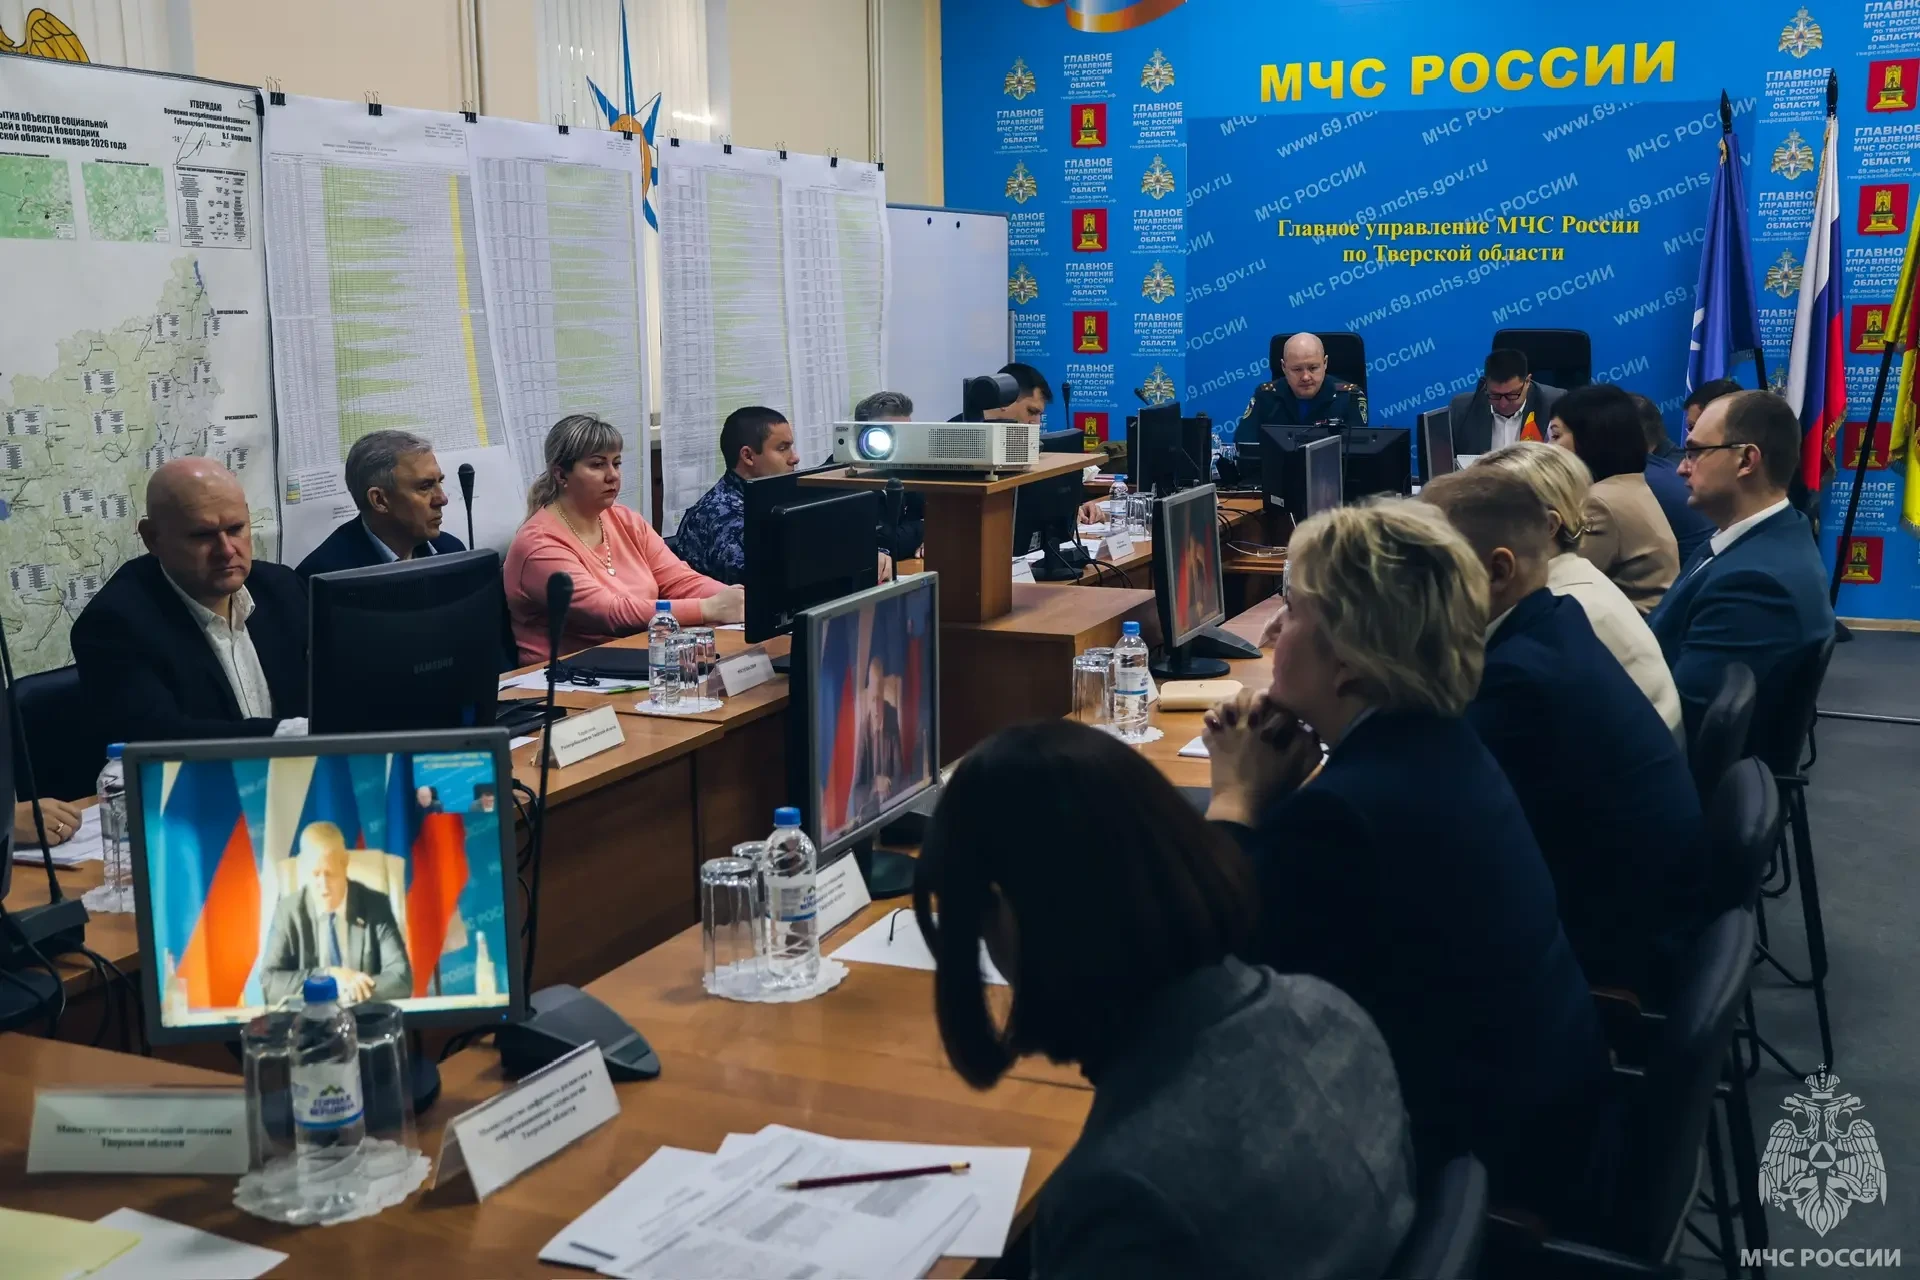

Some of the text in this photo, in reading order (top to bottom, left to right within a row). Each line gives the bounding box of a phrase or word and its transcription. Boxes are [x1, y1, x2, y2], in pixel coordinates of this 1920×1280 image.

[1863, 20, 1886, 29] МЧС
[1063, 52, 1113, 64] ГЛАВНОЕ
[1063, 61, 1113, 70] УПРАВЛЕНИЕ
[1081, 68, 1113, 76] РОССИИ
[1260, 40, 1676, 102] МЧС РОССИИ
[1766, 67, 1832, 82] ГЛАВНОЕ
[1070, 81, 1106, 89] ОБЛАСТИ
[1765, 89, 1786, 97] МЧС
[189, 99, 222, 112] УТВЕРЖДАЮ
[1132, 101, 1183, 112] ГЛАВНОЕ
[1773, 100, 1820, 110] ОБЛАСТИ
[996, 108, 1044, 119] ГЛАВНОЕ
[1132, 110, 1183, 119] УПРАВЛЕНИЕ
[20, 111, 61, 125] объектов
[61, 116, 109, 129] социальной
[996, 117, 1044, 126] УПРАВЛЕНИЕ
[1151, 117, 1183, 126] РОССИИ
[15, 123, 21, 131] в
[21, 123, 53, 135] период
[53, 125, 100, 138] Новогодних
[1014, 124, 1044, 132] РОССИИ
[1421, 117, 1463, 146] МЧС
[1627, 97, 1757, 163] МЧС РОСИИ
[1855, 124, 1920, 137] ГЛАВНОЕ
[1139, 130, 1176, 138] ОБЛАСТИ
[1276, 110, 1379, 158] www.69.m
[20, 133, 55, 144] области
[56, 136, 62, 145] в
[62, 137, 90, 147] январе
[90, 138, 109, 149] 2026
[109, 141, 127, 151] года
[1003, 136, 1038, 144] ОБЛАСТИ
[1854, 134, 1920, 145] УПРАВЛЕНИЕ
[1853, 142, 1920, 153] МЧС РОССИИ
[1064, 157, 1113, 168] ГЛАВНОЕ
[1861, 156, 1911, 166] ОБЛАСТИ
[1064, 167, 1113, 175] УПРАВЛЕНИЕ
[1254, 160, 1368, 223] МЧС РОССИИ
[1499, 172, 1579, 217] РОССИИ
[1759, 190, 1814, 202] ГЛАВНО
[1758, 200, 1815, 209] УПРАВЛЕНИ
[1011, 212, 1045, 221] АВНОЕ
[1133, 208, 1183, 218] ГЛАВНОЕ
[1758, 208, 1815, 217] МЧС РОССИ
[1133, 217, 1183, 225] УПРАВЛЕНИЕ
[1766, 221, 1812, 230] ОБЛАСТИ
[1277, 215, 1641, 240] Главное управление МЧС России
[1342, 243, 1565, 266] по Тверской области
[1065, 262, 1114, 271] ГЛАВНОЕ
[1845, 257, 1904, 266] УПРАВЛЕНИ
[1289, 282, 1326, 308] МЧС
[1492, 264, 1615, 325] МЧС РОССИИ
[1613, 284, 1699, 326] www.69.
[1014, 313, 1046, 322] АВНОЕ
[1134, 312, 1184, 321] ГЛАВНОЕ
[1134, 321, 1183, 329] УПРАВЛЕНИЕ
[1365, 337, 1436, 377] РОССИИ
[1066, 364, 1115, 373] ГЛАВНОЕ
[1591, 355, 1650, 386] ССИИ
[1858, 499, 1895, 507] ОССИИ
[1838, 511, 1885, 519] ОАСТИ
